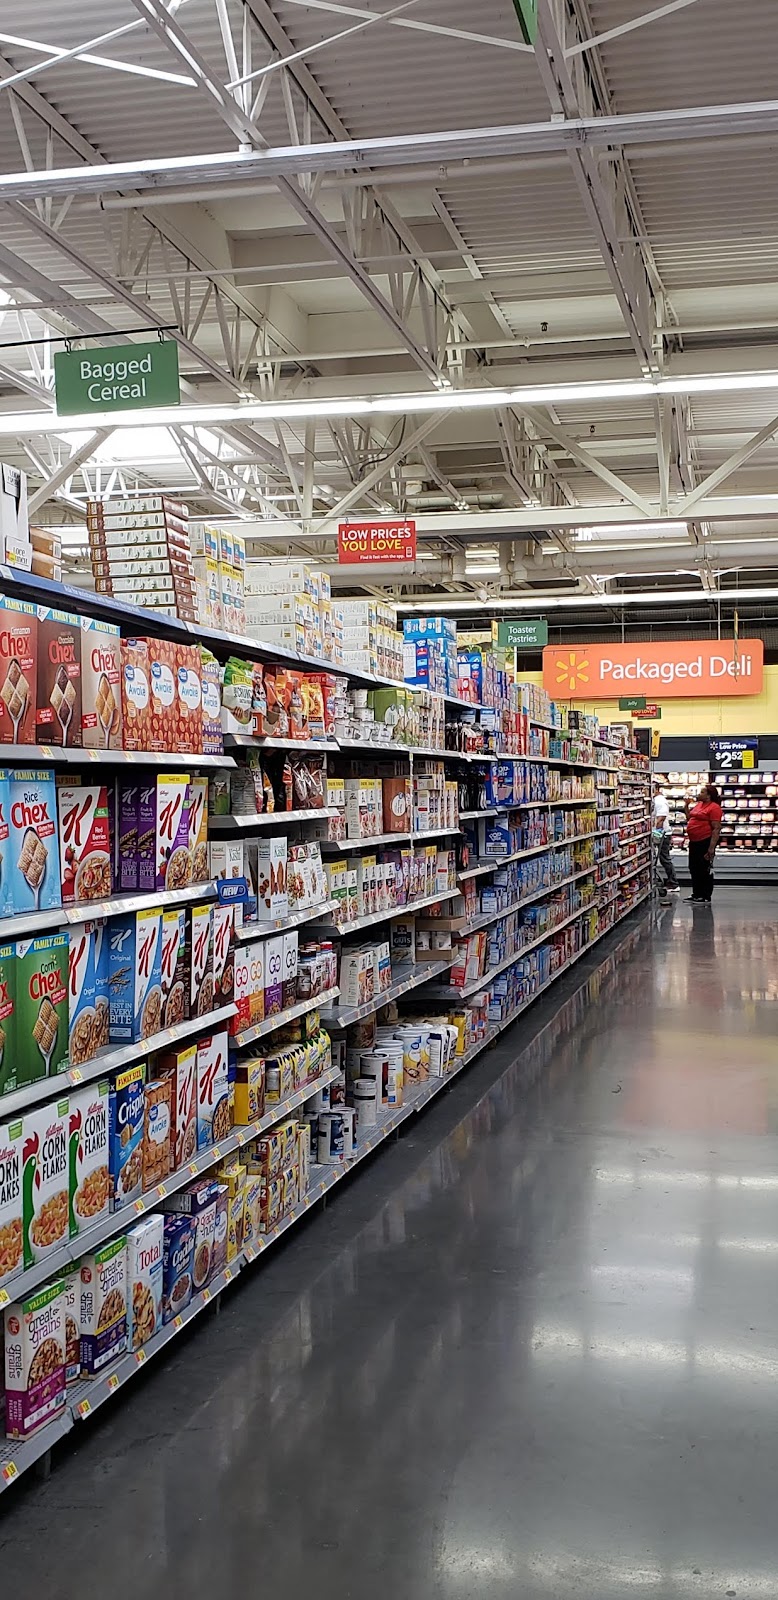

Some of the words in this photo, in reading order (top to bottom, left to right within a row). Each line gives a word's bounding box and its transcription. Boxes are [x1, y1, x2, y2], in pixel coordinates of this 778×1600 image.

[80, 354, 152, 382] Bagged
[87, 378, 147, 402] Cereal
[341, 540, 367, 552] YOU
[370, 538, 404, 551] LOVE.
[342, 530, 368, 541] LOW
[370, 527, 411, 540] PRICES
[4, 598, 22, 612] FAMILY
[52, 609, 68, 622] FAMILY
[11, 627, 31, 635] Cinnamon
[507, 633, 538, 643] Pastries
[508, 625, 537, 635] Toaster
[0, 631, 31, 657] Chex
[48, 640, 76, 664] Chex
[91, 648, 117, 673] Chex
[599, 655, 702, 684] Packaged
[709, 654, 752, 677] Deli
[128, 684, 146, 697] Awake
[154, 681, 172, 694] Awake
[181, 687, 198, 698] Awake
[203, 697, 218, 708] Awake
[14, 771, 36, 780] FAMILY
[37, 771, 50, 780] SIZE
[24, 791, 39, 804] Rice
[122, 787, 138, 804] K
[140, 787, 156, 804] K
[11, 802, 50, 829] Chex
[62, 794, 93, 846] K
[160, 793, 181, 840] K
[222, 885, 238, 897] NEW
[33, 939, 52, 950] FAMILY
[53, 936, 65, 946] SIZE
[110, 929, 132, 952] K
[194, 922, 210, 970] K
[215, 914, 231, 960] K
[0, 946, 12, 957] SIZE
[138, 926, 157, 978] K
[161, 929, 179, 978] K
[40, 961, 55, 974] Corn
[69, 936, 86, 996] K
[29, 969, 63, 1000] Chex
[110, 1014, 132, 1025] BITE
[118, 1073, 133, 1087] FAMILY
[132, 1069, 142, 1080] SIZE
[199, 1053, 222, 1105] K
[178, 1066, 193, 1116] K
[84, 1110, 106, 1138] CORN
[150, 1120, 167, 1135] Awake
[42, 1131, 66, 1162] CORN
[84, 1130, 107, 1156] FLAKES
[257, 1142, 267, 1152] 12
[0, 1155, 19, 1186] ORN
[42, 1152, 67, 1182] FLAKES
[0, 1178, 20, 1205] AKES
[261, 1188, 267, 1198] 2
[139, 1240, 161, 1271] Total
[99, 1260, 118, 1282] great
[100, 1270, 124, 1297] grains
[28, 1295, 45, 1311] VALUE
[46, 1286, 60, 1300] SIZE
[28, 1304, 53, 1333] great
[29, 1315, 61, 1349] grains
[6, 1343, 16, 1379] grains
[14, 1344, 23, 1373] great
